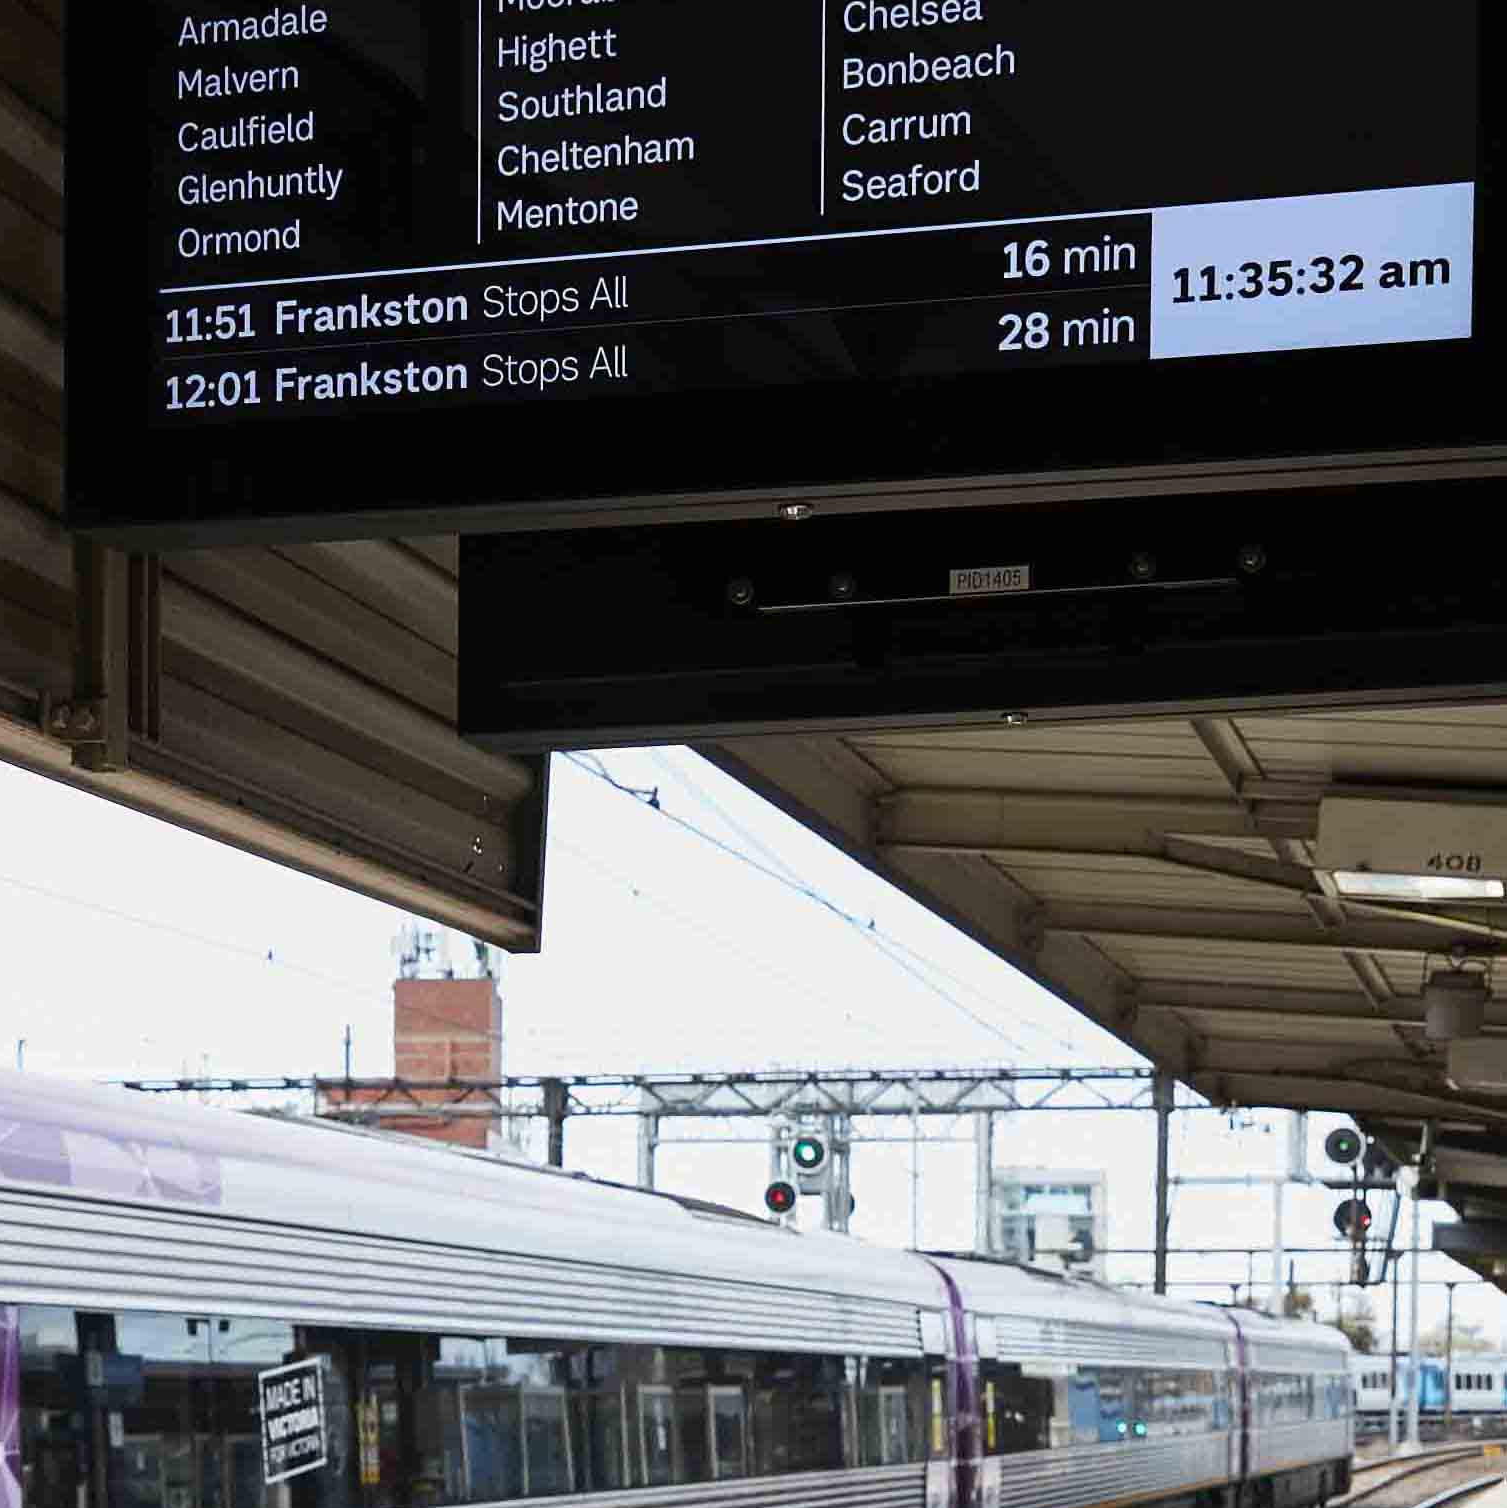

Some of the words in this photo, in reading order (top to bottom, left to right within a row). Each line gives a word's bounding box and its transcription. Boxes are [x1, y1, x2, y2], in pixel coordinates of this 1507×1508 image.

[178, 4, 328, 47] Armadale
[844, 0, 983, 33] Chelsea
[498, 28, 617, 73] Highett
[843, 43, 1015, 90] Bonbeach
[178, 65, 299, 100] Malvern
[498, 76, 667, 122] Southland
[178, 111, 314, 153] Caulfield
[842, 106, 971, 146] Carrum
[497, 134, 695, 177] Cheltenham
[178, 163, 344, 205] Glenhuntly
[842, 160, 980, 202] Seaford
[497, 192, 639, 231] Mentone
[178, 218, 300, 258] Ormond
[1003, 239, 1051, 279] 16
[1064, 235, 1136, 275] min
[1172, 254, 1365, 304] 11:35:32
[1378, 257, 1450, 289] am
[166, 303, 256, 343] 11:51
[276, 293, 468, 336] Frankston
[483, 285, 579, 323] Stops
[589, 275, 629, 310] All
[998, 311, 1050, 351] 28
[1063, 308, 1135, 347] min
[166, 370, 261, 410] 12:01
[275, 361, 468, 403] Frankston
[483, 353, 579, 392] Stops
[589, 344, 628, 379] All
[957, 569, 1021, 589] PID1405
